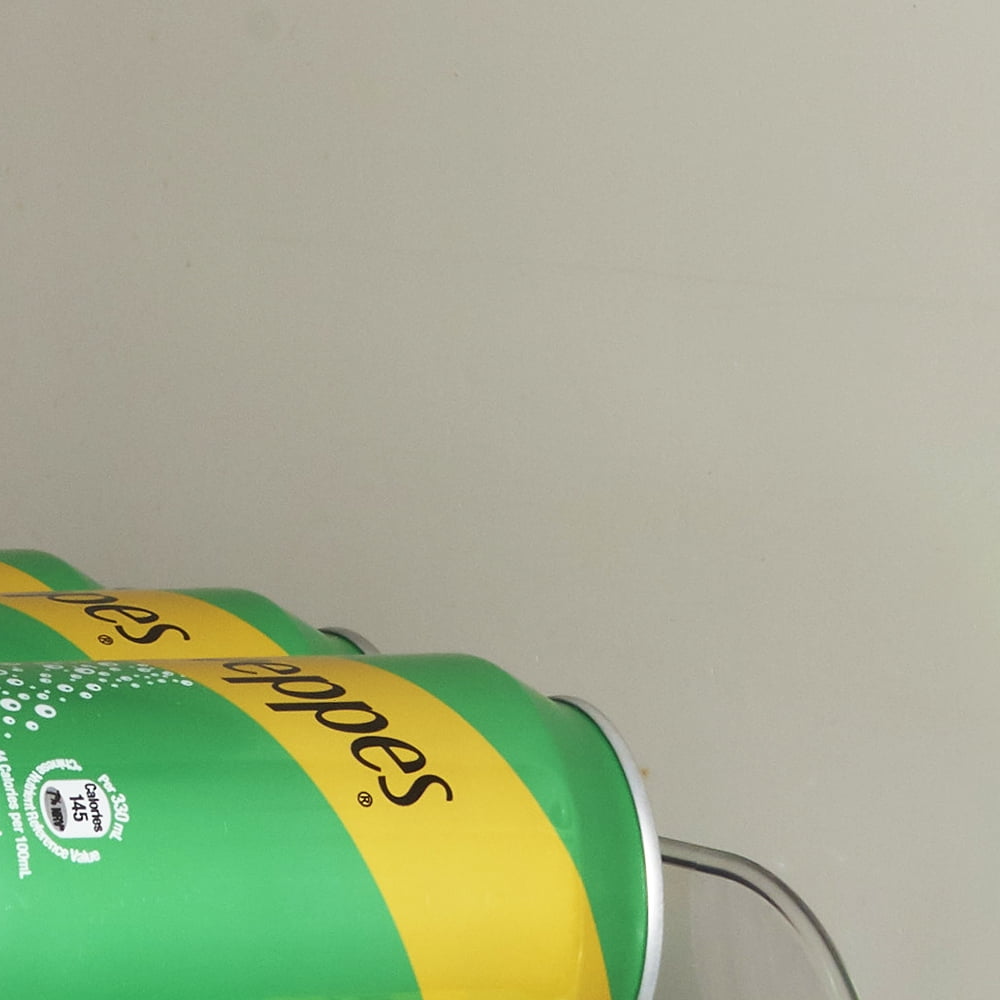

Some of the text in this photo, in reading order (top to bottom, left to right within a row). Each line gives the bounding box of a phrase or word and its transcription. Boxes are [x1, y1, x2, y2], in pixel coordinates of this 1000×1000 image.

[69, 793, 89, 823] 145
[84, 783, 104, 833] Calories
[97, 773, 117, 794] Per
[110, 793, 130, 823] 330
[8, 812, 25, 835] per
[15, 835, 33, 880] 100mL
